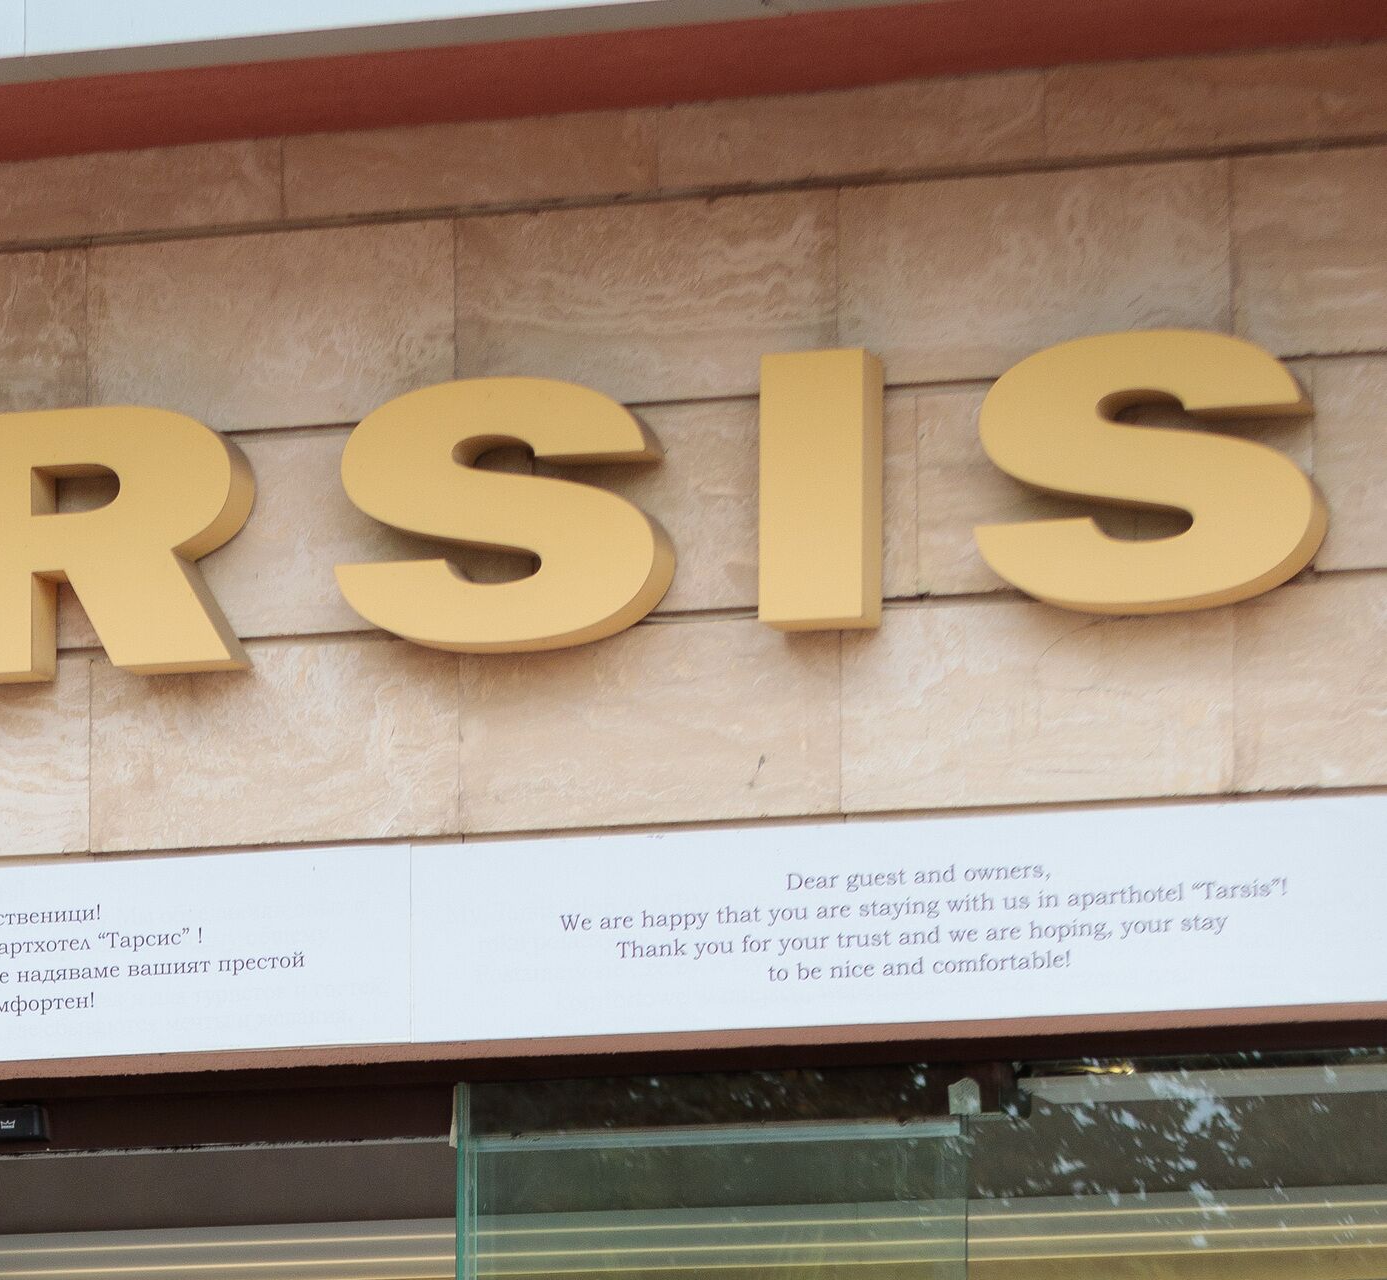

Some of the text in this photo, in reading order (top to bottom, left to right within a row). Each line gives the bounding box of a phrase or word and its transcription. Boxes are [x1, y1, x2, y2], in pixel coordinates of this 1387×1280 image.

[786, 863, 1051, 893] Dear guest and owners,
[558, 912, 592, 932] We
[599, 915, 634, 930] are
[640, 909, 710, 932] happy
[716, 905, 762, 925] that
[767, 906, 808, 927] you
[816, 904, 852, 920] are
[859, 895, 941, 921] staying
[945, 892, 995, 913] with
[1002, 895, 1031, 911] us
[1037, 889, 1059, 909] in
[1067, 882, 1184, 912] aparthotel
[615, 937, 688, 960] Thank
[693, 940, 734, 961] you
[741, 934, 773, 954] for
[777, 935, 830, 957] your
[836, 929, 892, 949] trust
[898, 924, 941, 946] and
[947, 928, 979, 944] we
[985, 926, 1022, 942] are
[1028, 918, 1113, 944] hoping,
[1119, 918, 1174, 941] your
[1180, 915, 1229, 936] stay
[16, 965, 121, 985] надяваме
[127, 959, 212, 978] вашият
[217, 950, 305, 977] престой
[767, 965, 789, 982] to
[796, 961, 823, 981] be
[829, 959, 875, 980] nice
[882, 955, 925, 977] and
[932, 948, 1071, 975] comfortable!
